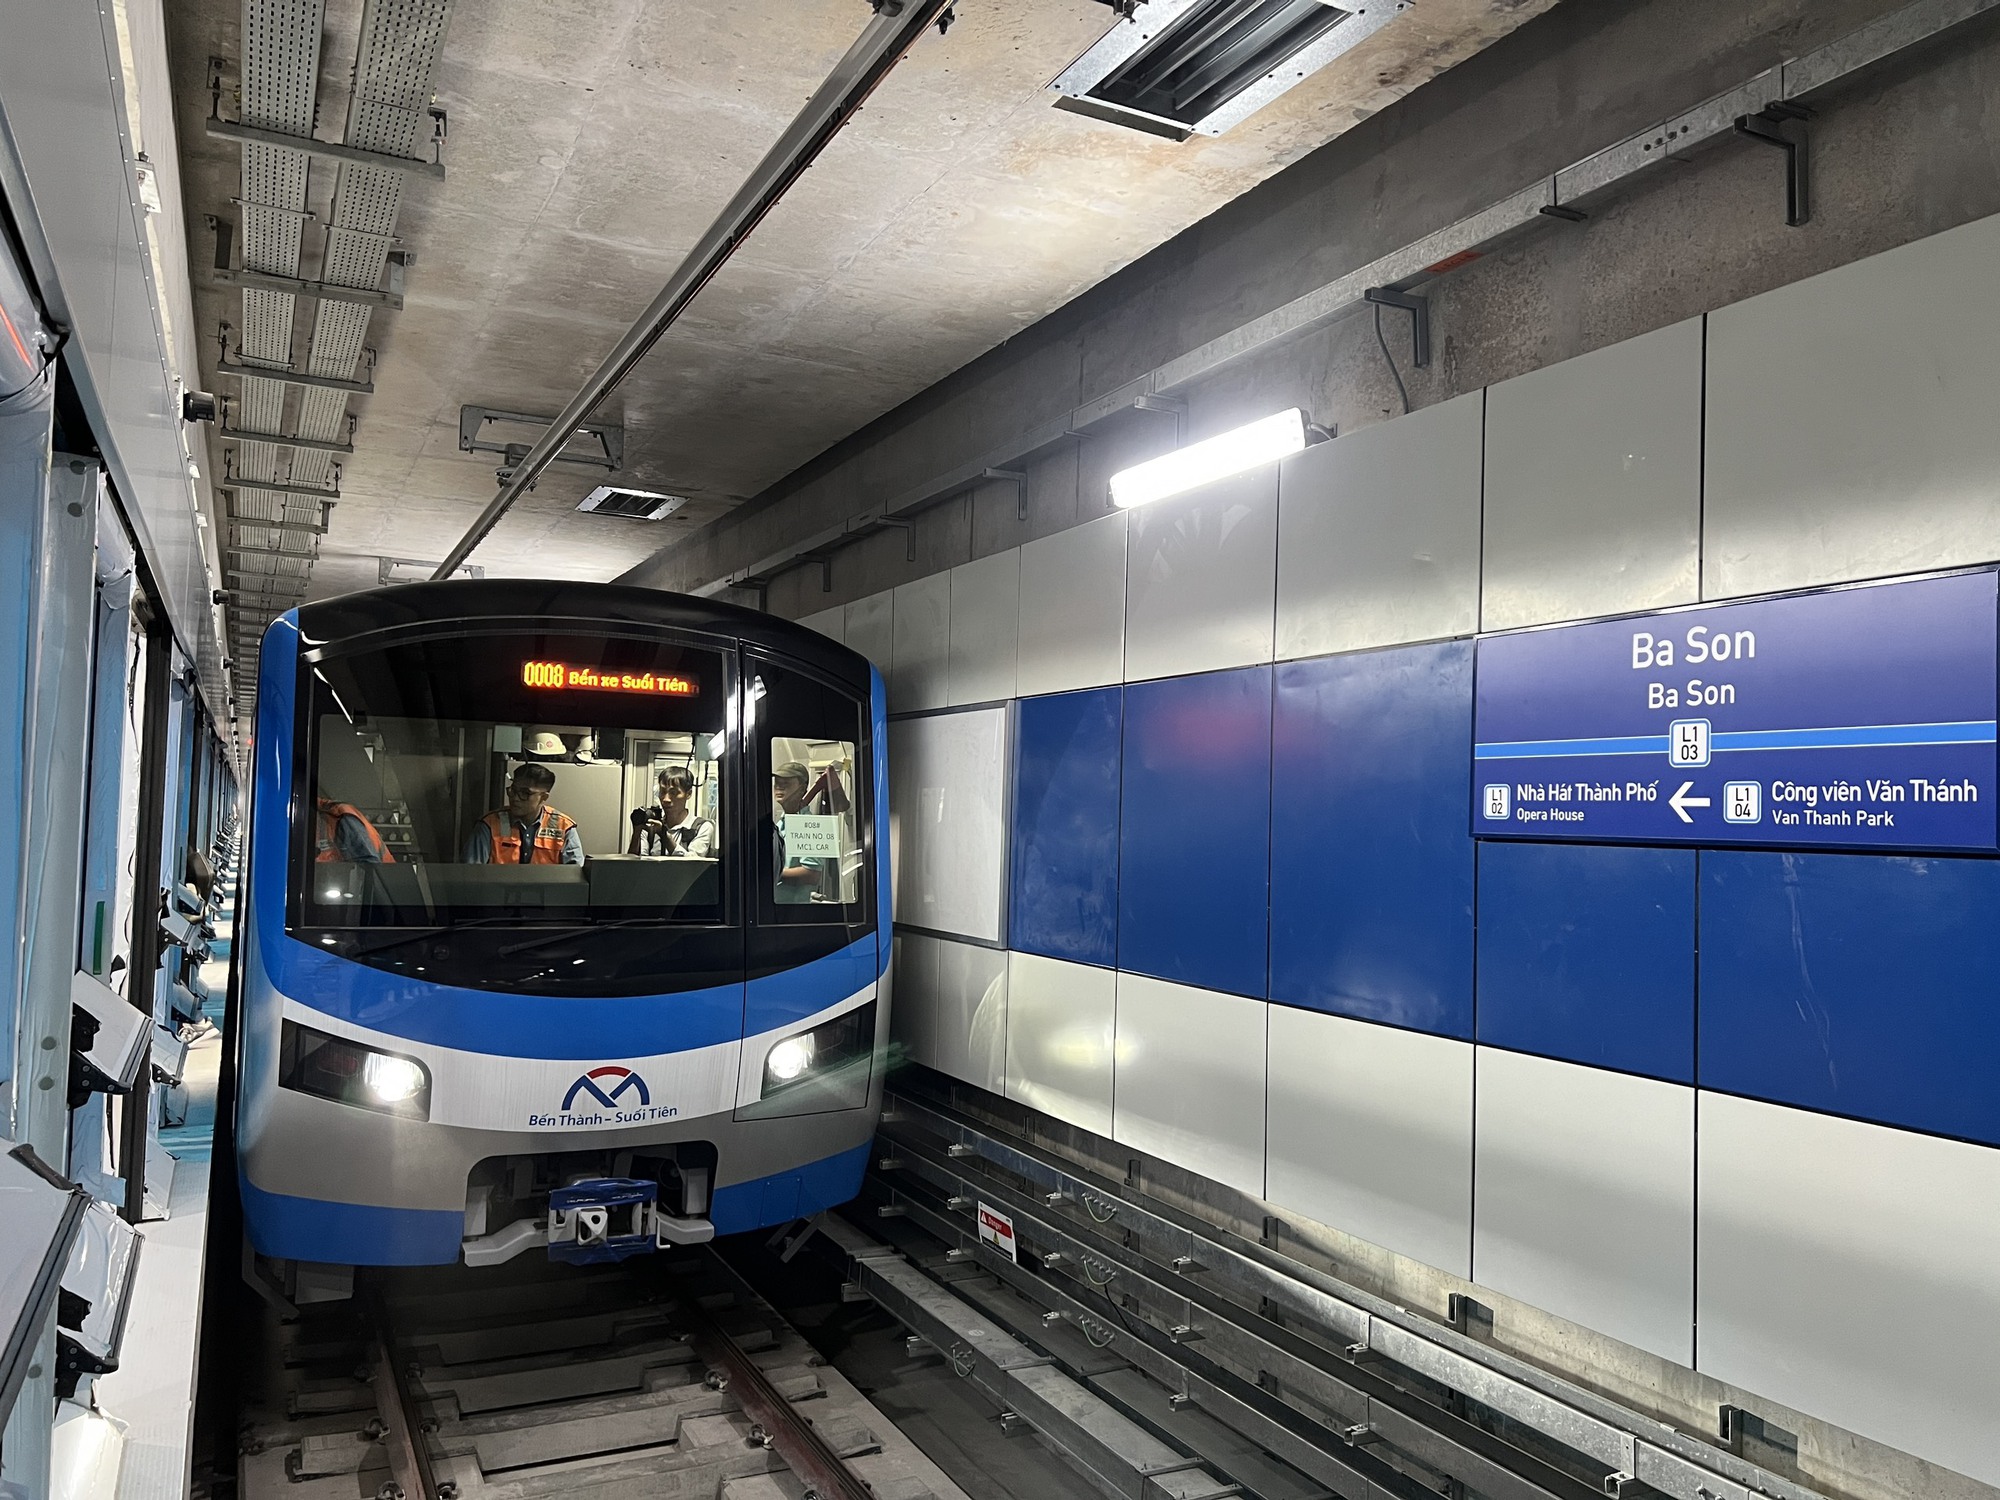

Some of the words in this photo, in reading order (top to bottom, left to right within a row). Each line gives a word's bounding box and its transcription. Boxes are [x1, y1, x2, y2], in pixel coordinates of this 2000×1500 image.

[1632, 632, 1674, 669] Ba
[1685, 625, 1756, 664] Son
[524, 661, 564, 687] 0008
[569, 668, 597, 686] Bến
[600, 676, 619, 688] xe
[621, 672, 654, 690] Suối
[656, 676, 688, 693] Tiên
[1648, 682, 1679, 709] Ba
[1686, 679, 1735, 707] Son
[1681, 726, 1699, 743] L1
[1680, 743, 1699, 761] 03
[1491, 788, 1503, 801] L1
[1516, 783, 1545, 801] Nhà
[1548, 783, 1573, 801] Hát
[1575, 782, 1621, 801] Thành
[1626, 780, 1660, 801] Phố
[1735, 787, 1750, 802] L1
[1771, 780, 1818, 807] Công
[1822, 780, 1861, 802] viên
[1865, 779, 1905, 802] Văn
[1909, 778, 1978, 802] Thánh
[1491, 802, 1503, 815] 02
[1516, 807, 1548, 823] Opera
[1550, 808, 1585, 821] House
[1734, 803, 1751, 818] 04
[1772, 810, 1800, 825] Van
[1803, 809, 1851, 826] Thanh
[1856, 810, 1895, 827] Park
[529, 1113, 556, 1126] Bến
[559, 1112, 602, 1126] Thành
[615, 1108, 646, 1123] Suối
[648, 1105, 678, 1119] Tiên
